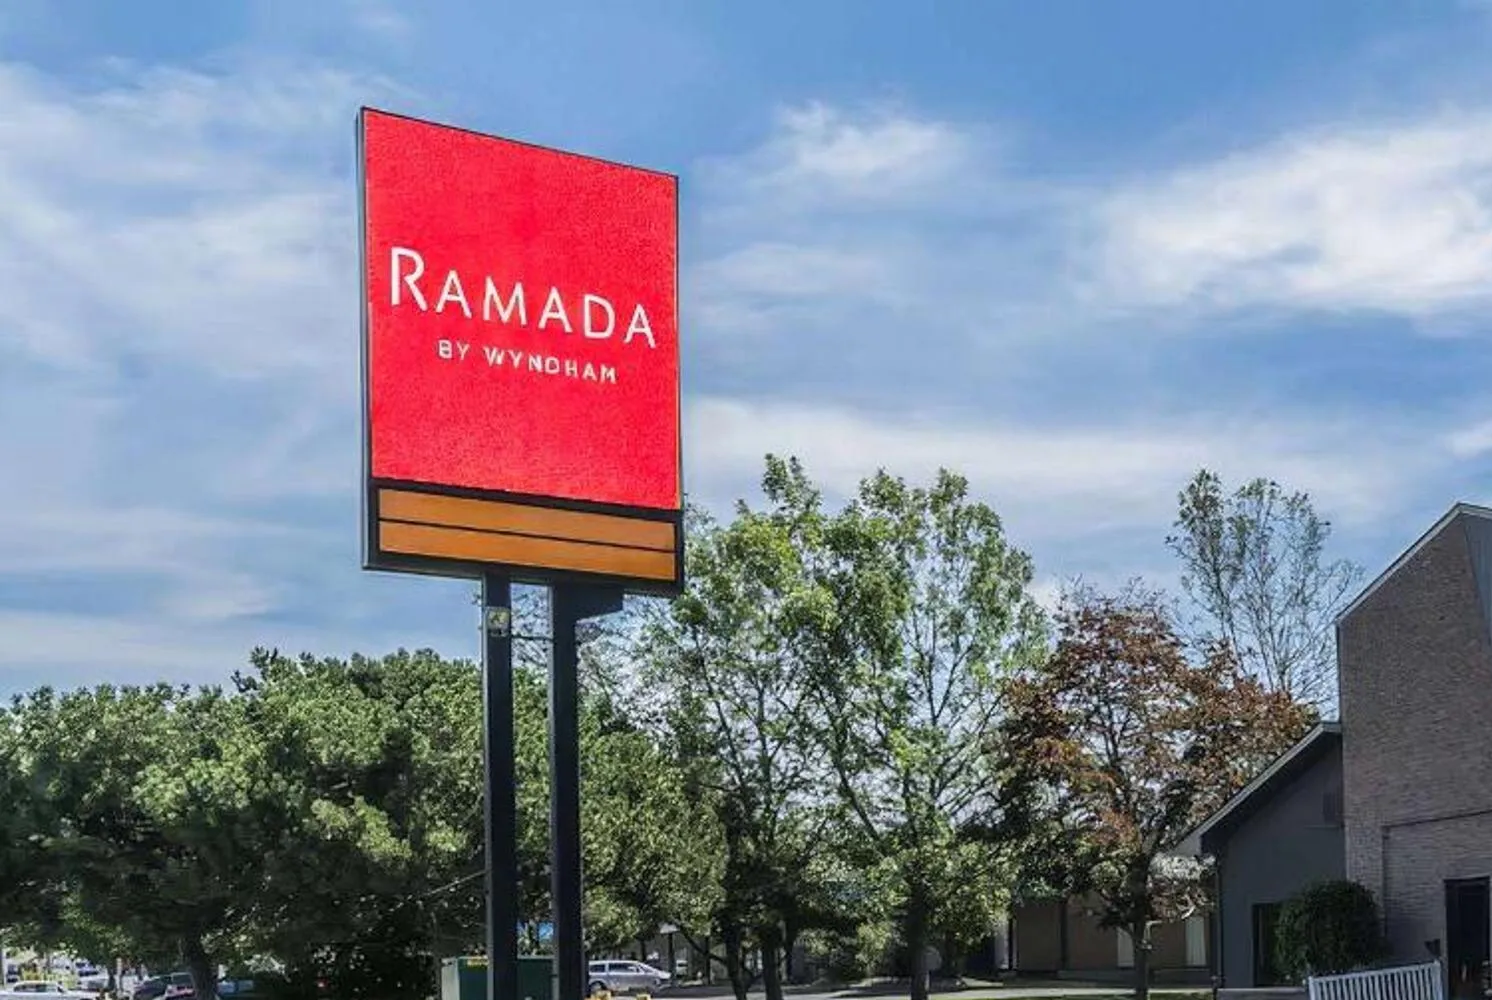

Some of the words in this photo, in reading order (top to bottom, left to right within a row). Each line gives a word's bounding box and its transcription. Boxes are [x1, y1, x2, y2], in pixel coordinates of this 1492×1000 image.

[390, 246, 656, 348] RAMADA
[438, 339, 470, 361] BY
[483, 345, 617, 384] WYNDHAM
